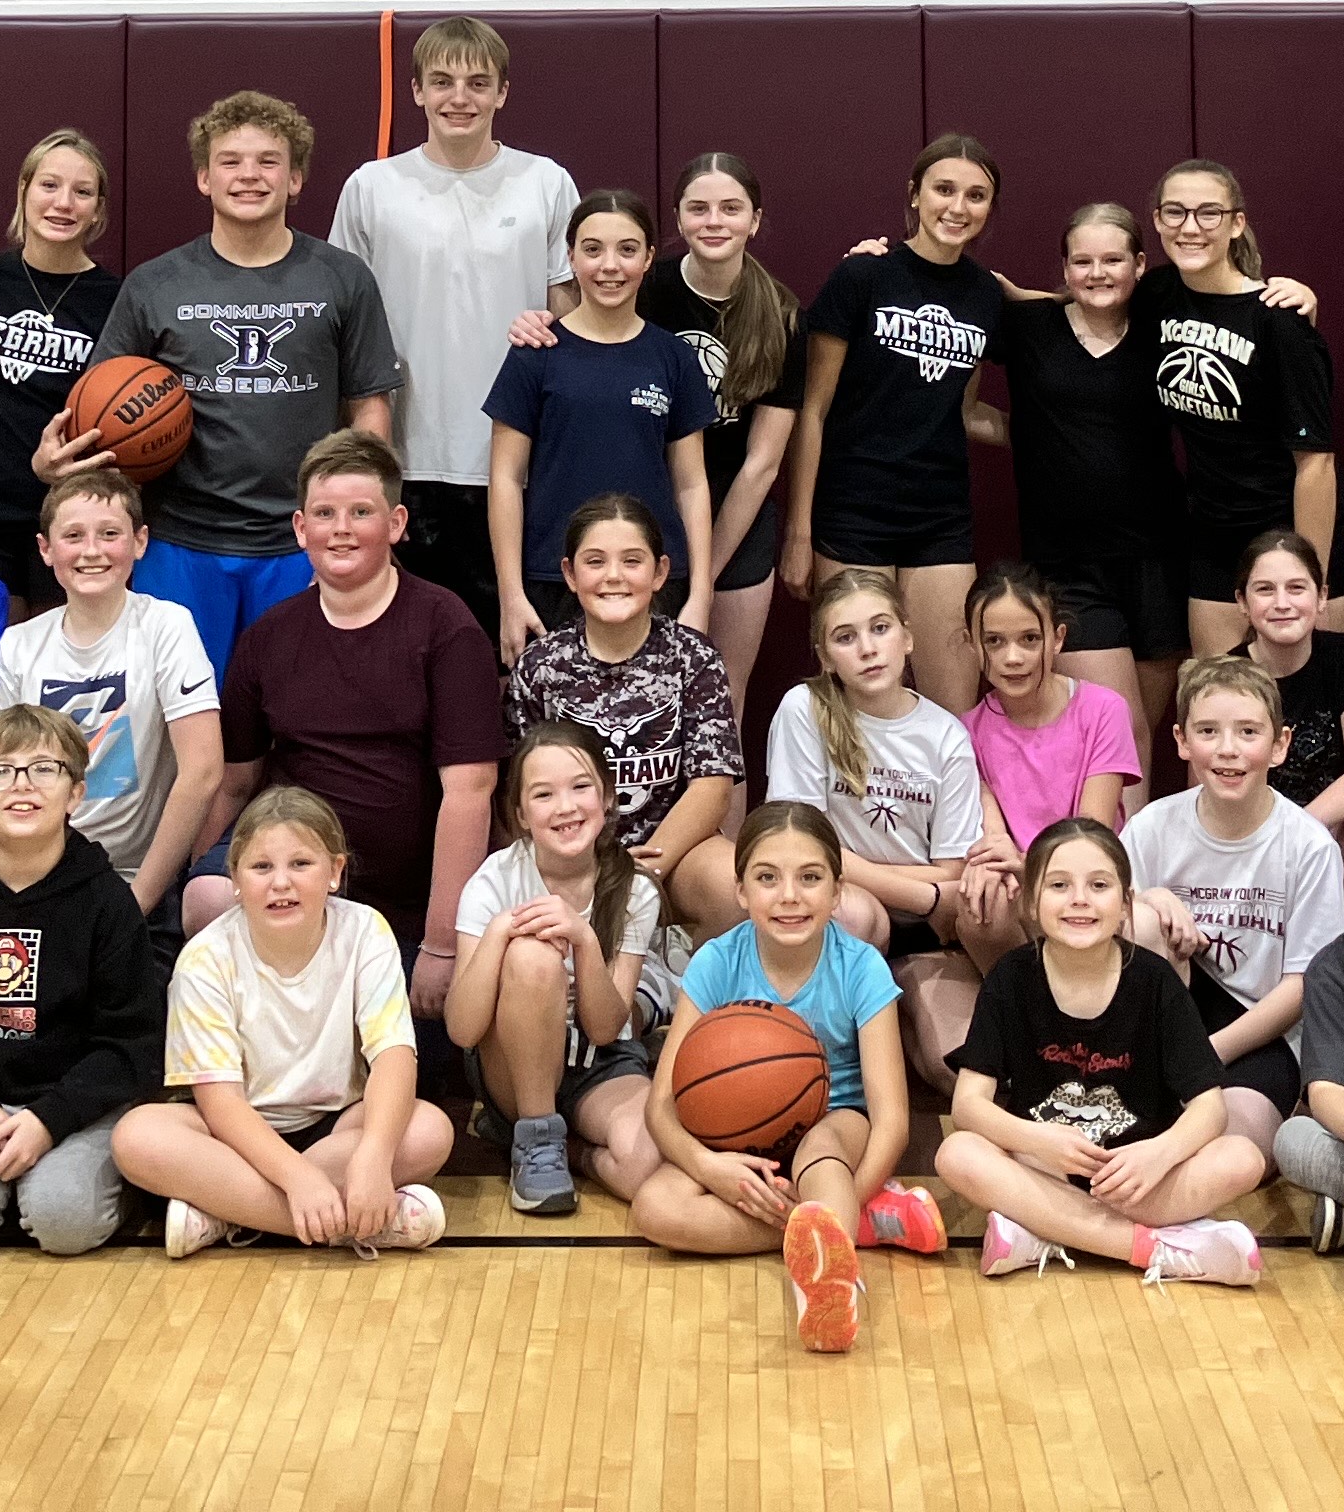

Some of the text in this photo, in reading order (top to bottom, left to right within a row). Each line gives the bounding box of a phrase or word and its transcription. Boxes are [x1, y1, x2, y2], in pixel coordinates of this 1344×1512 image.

[176, 301, 327, 321] COMMUNITY
[873, 311, 987, 359] MCGRAW
[112, 372, 184, 426] Wilson
[181, 374, 319, 394] BASEBALL
[1178, 378, 1206, 399] GIRLS
[609, 751, 678, 785] RAW
[833, 775, 933, 805] BAKETBALL
[1235, 887, 1266, 901] YOUTH
[1186, 901, 1285, 938] SKETBALL
